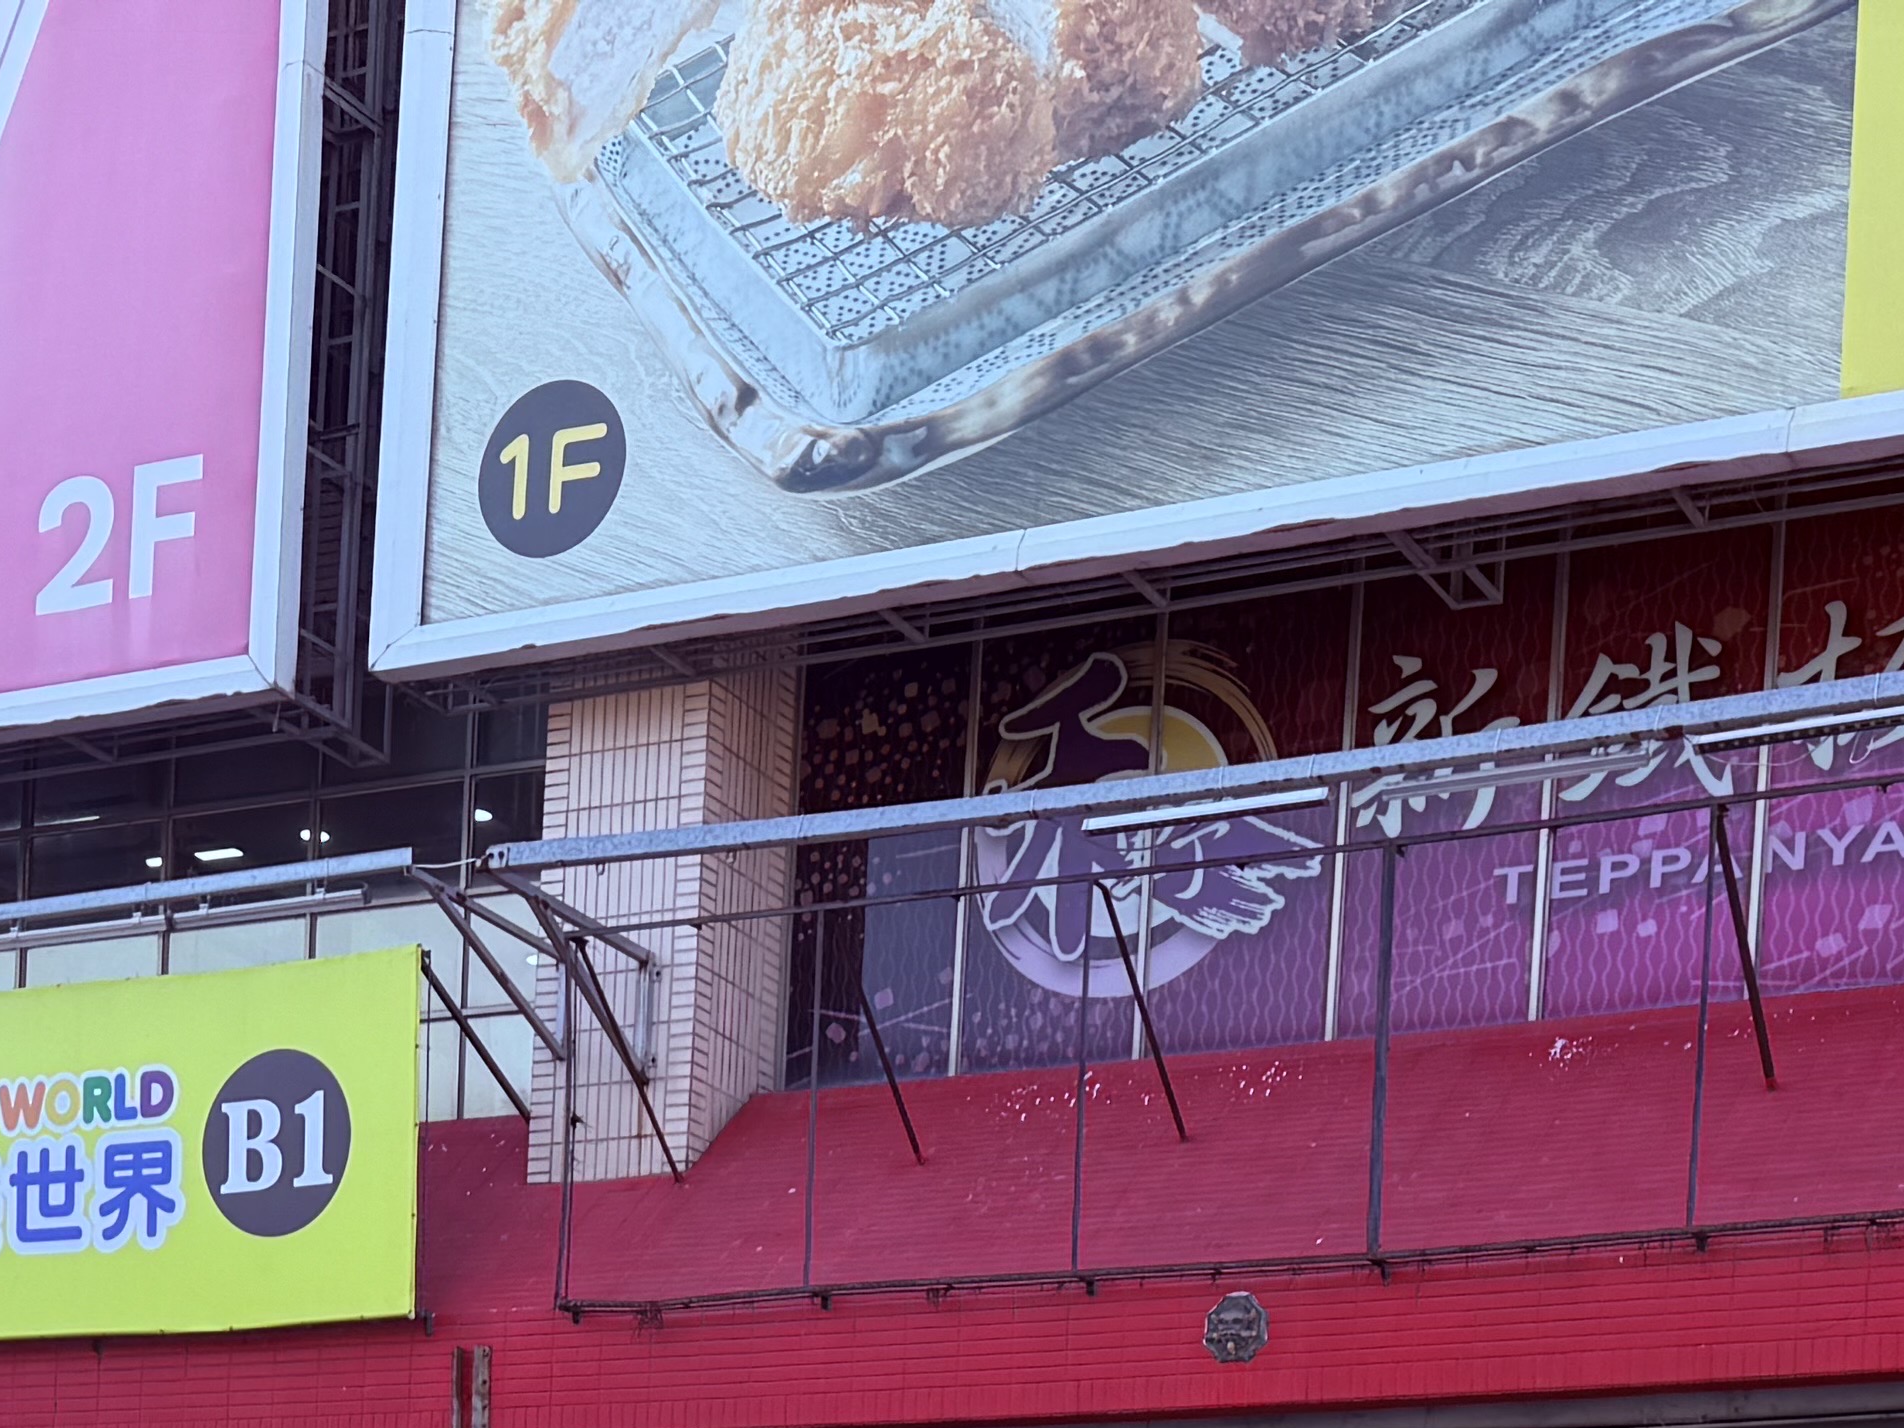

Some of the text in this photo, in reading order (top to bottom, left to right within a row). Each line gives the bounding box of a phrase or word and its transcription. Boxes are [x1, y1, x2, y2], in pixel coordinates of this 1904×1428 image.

[499, 423, 608, 520] 1F
[35, 455, 204, 615] 2F
[220, 1089, 334, 1195] B1
